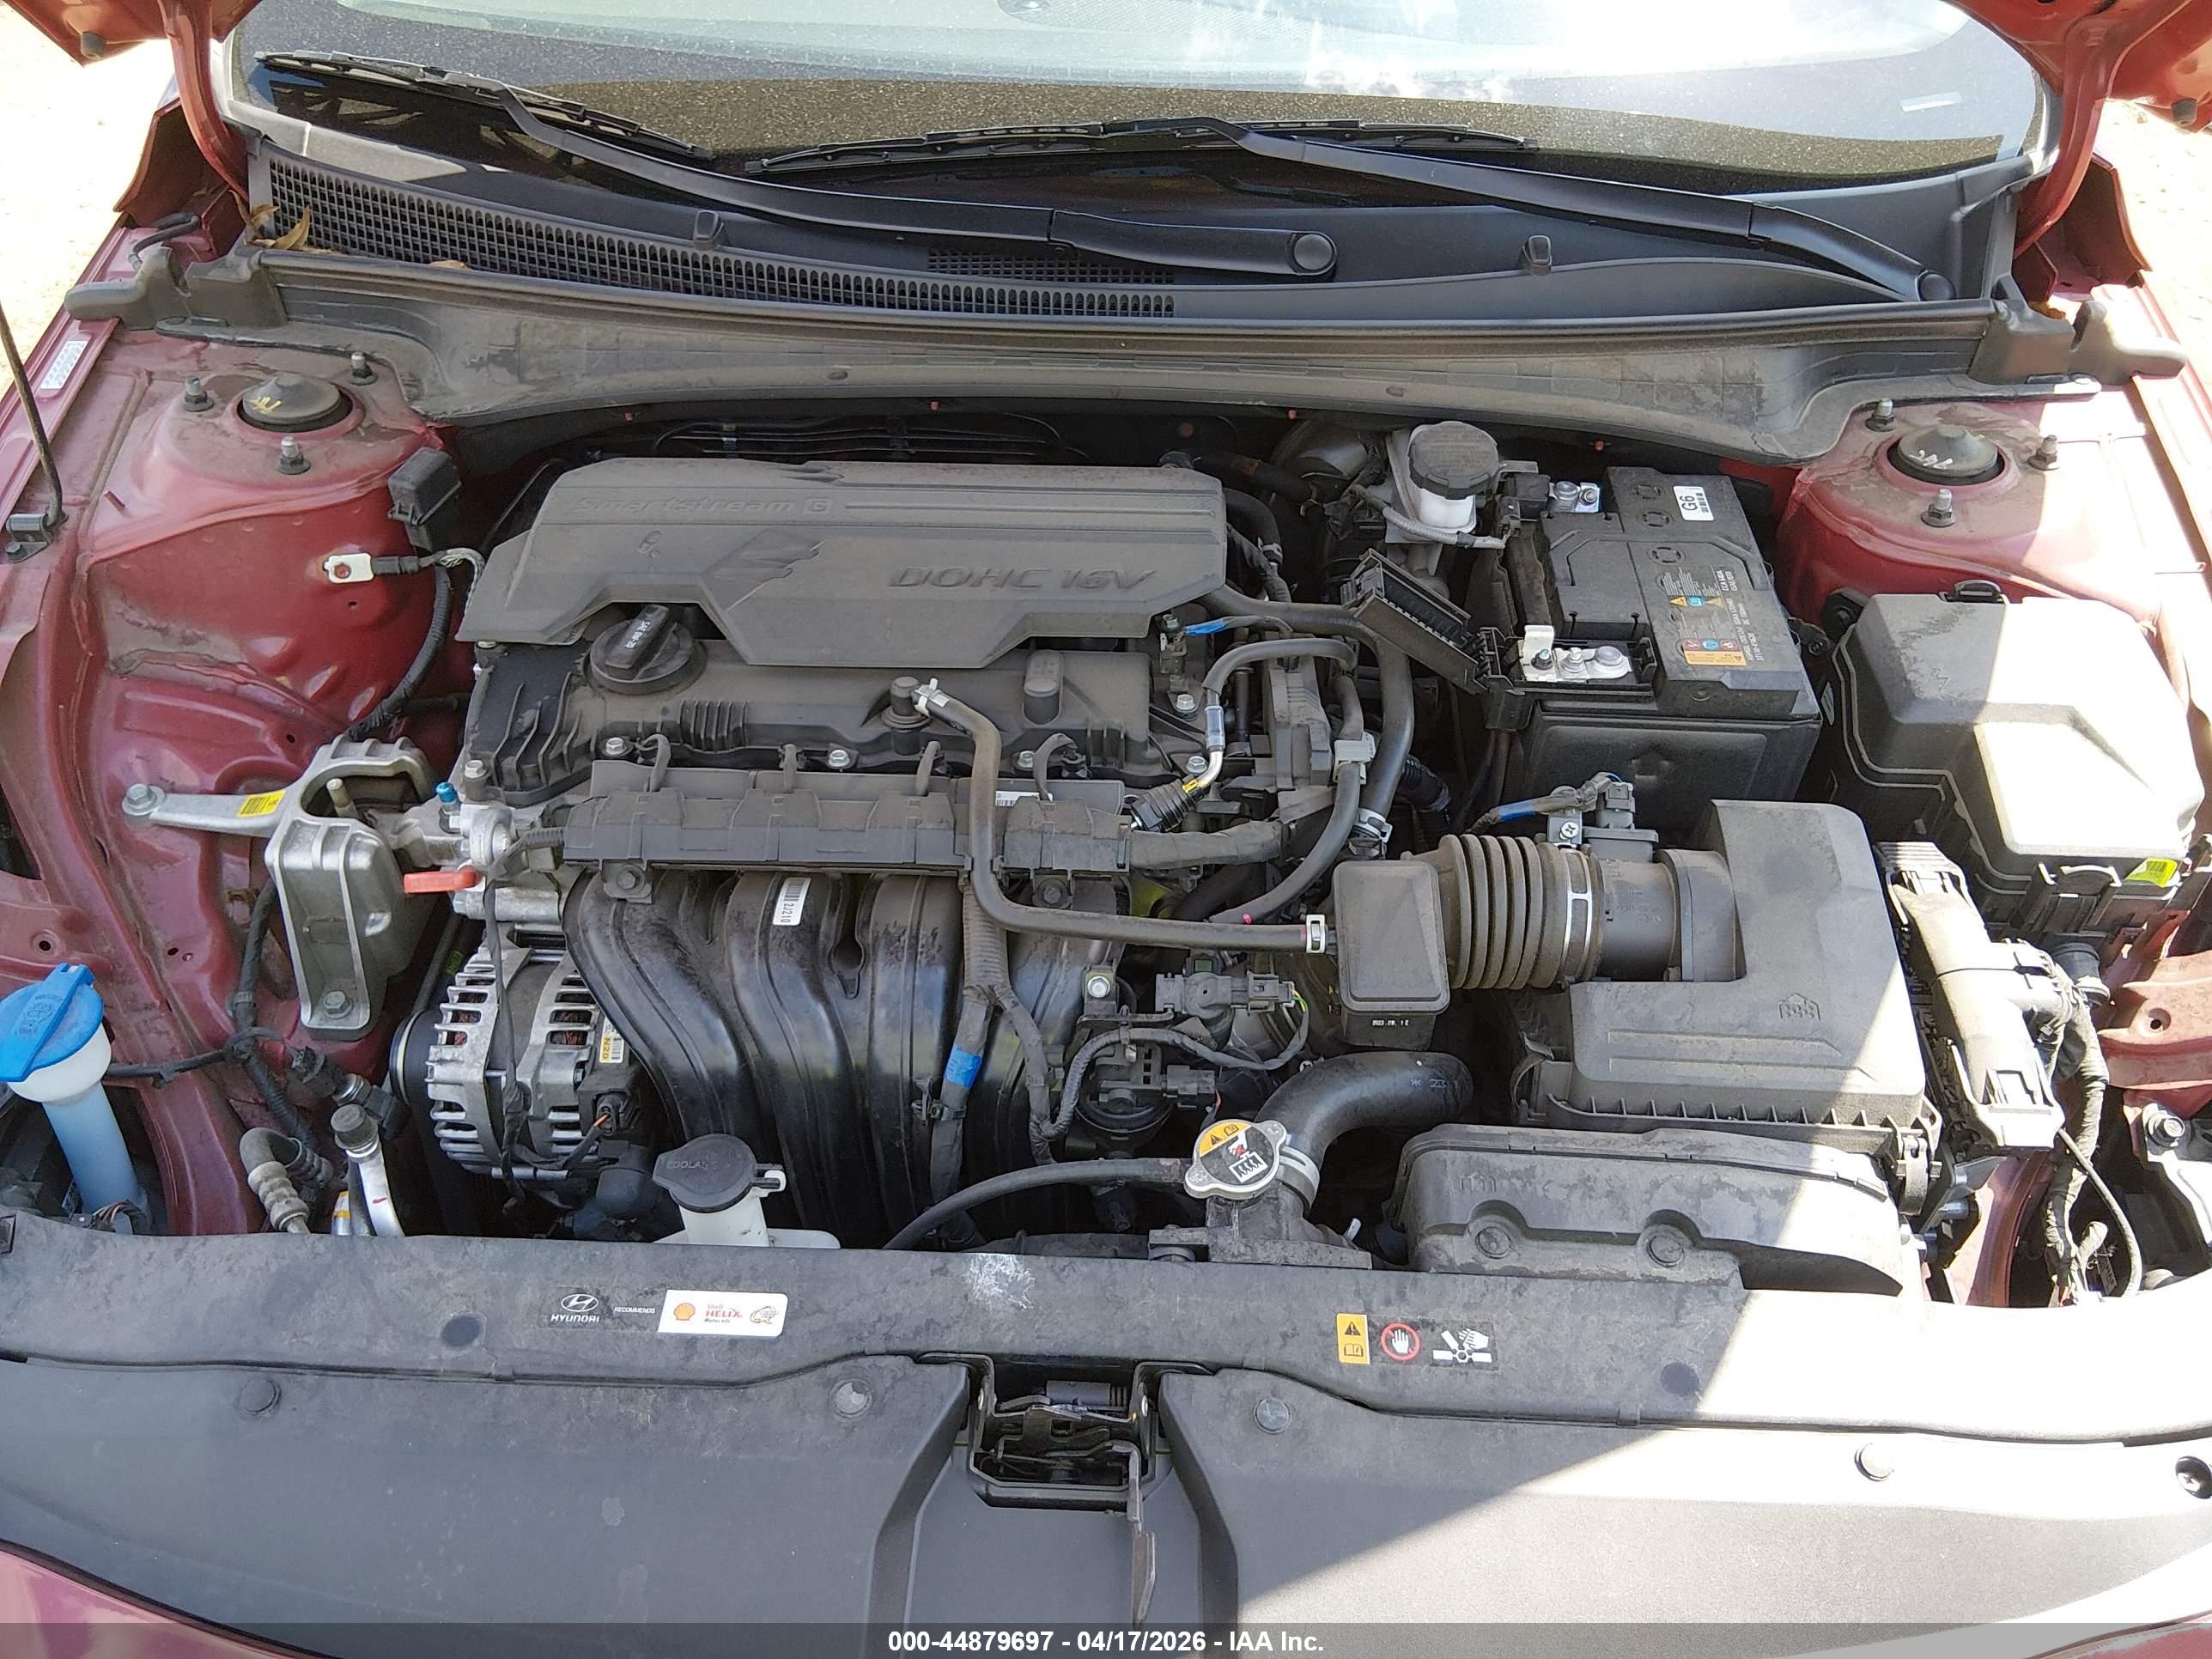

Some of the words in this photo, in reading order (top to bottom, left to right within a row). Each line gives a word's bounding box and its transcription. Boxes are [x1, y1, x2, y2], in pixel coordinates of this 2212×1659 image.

[573, 496, 795, 514] Smartstream
[807, 497, 830, 513] G
[1680, 495, 1698, 511] G6
[889, 566, 1051, 589] DOHC
[1060, 568, 1157, 591] 16V
[550, 1314, 600, 1323] HYUNDAI
[705, 1310, 742, 1318] HELIX
